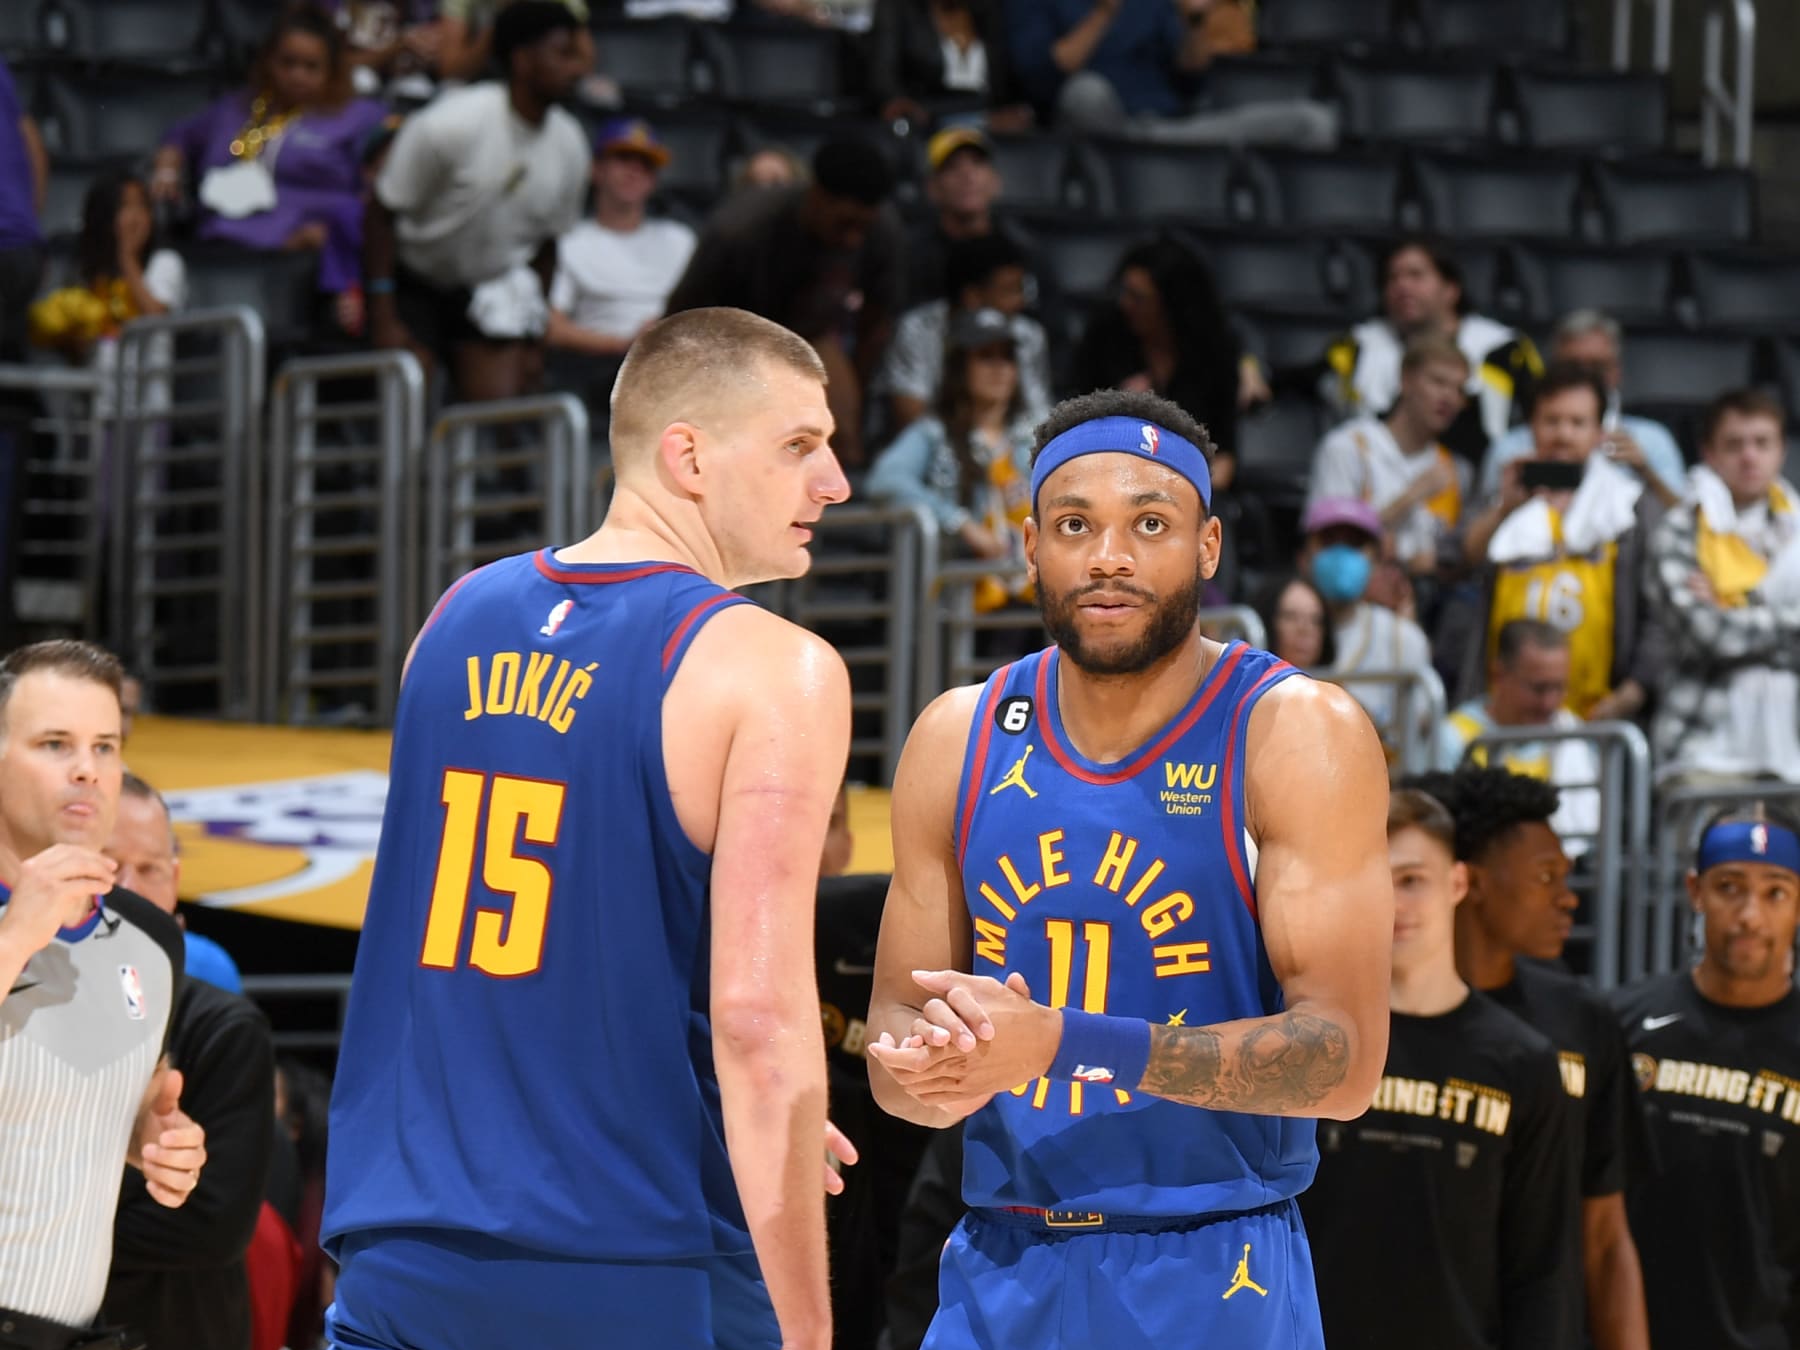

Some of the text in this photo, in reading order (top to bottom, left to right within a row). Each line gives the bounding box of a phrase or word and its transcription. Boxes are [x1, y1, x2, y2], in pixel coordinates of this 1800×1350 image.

[464, 651, 600, 734] JOKIĆ
[1003, 701, 1029, 731] 6
[1160, 791, 1211, 804] Western
[1164, 762, 1217, 789] WU
[1166, 803, 1201, 815] Union
[419, 766, 568, 980] 15
[974, 827, 1211, 979] MILE HIGH
[1045, 918, 1112, 1014] 11
[1656, 1058, 1750, 1104] BRING
